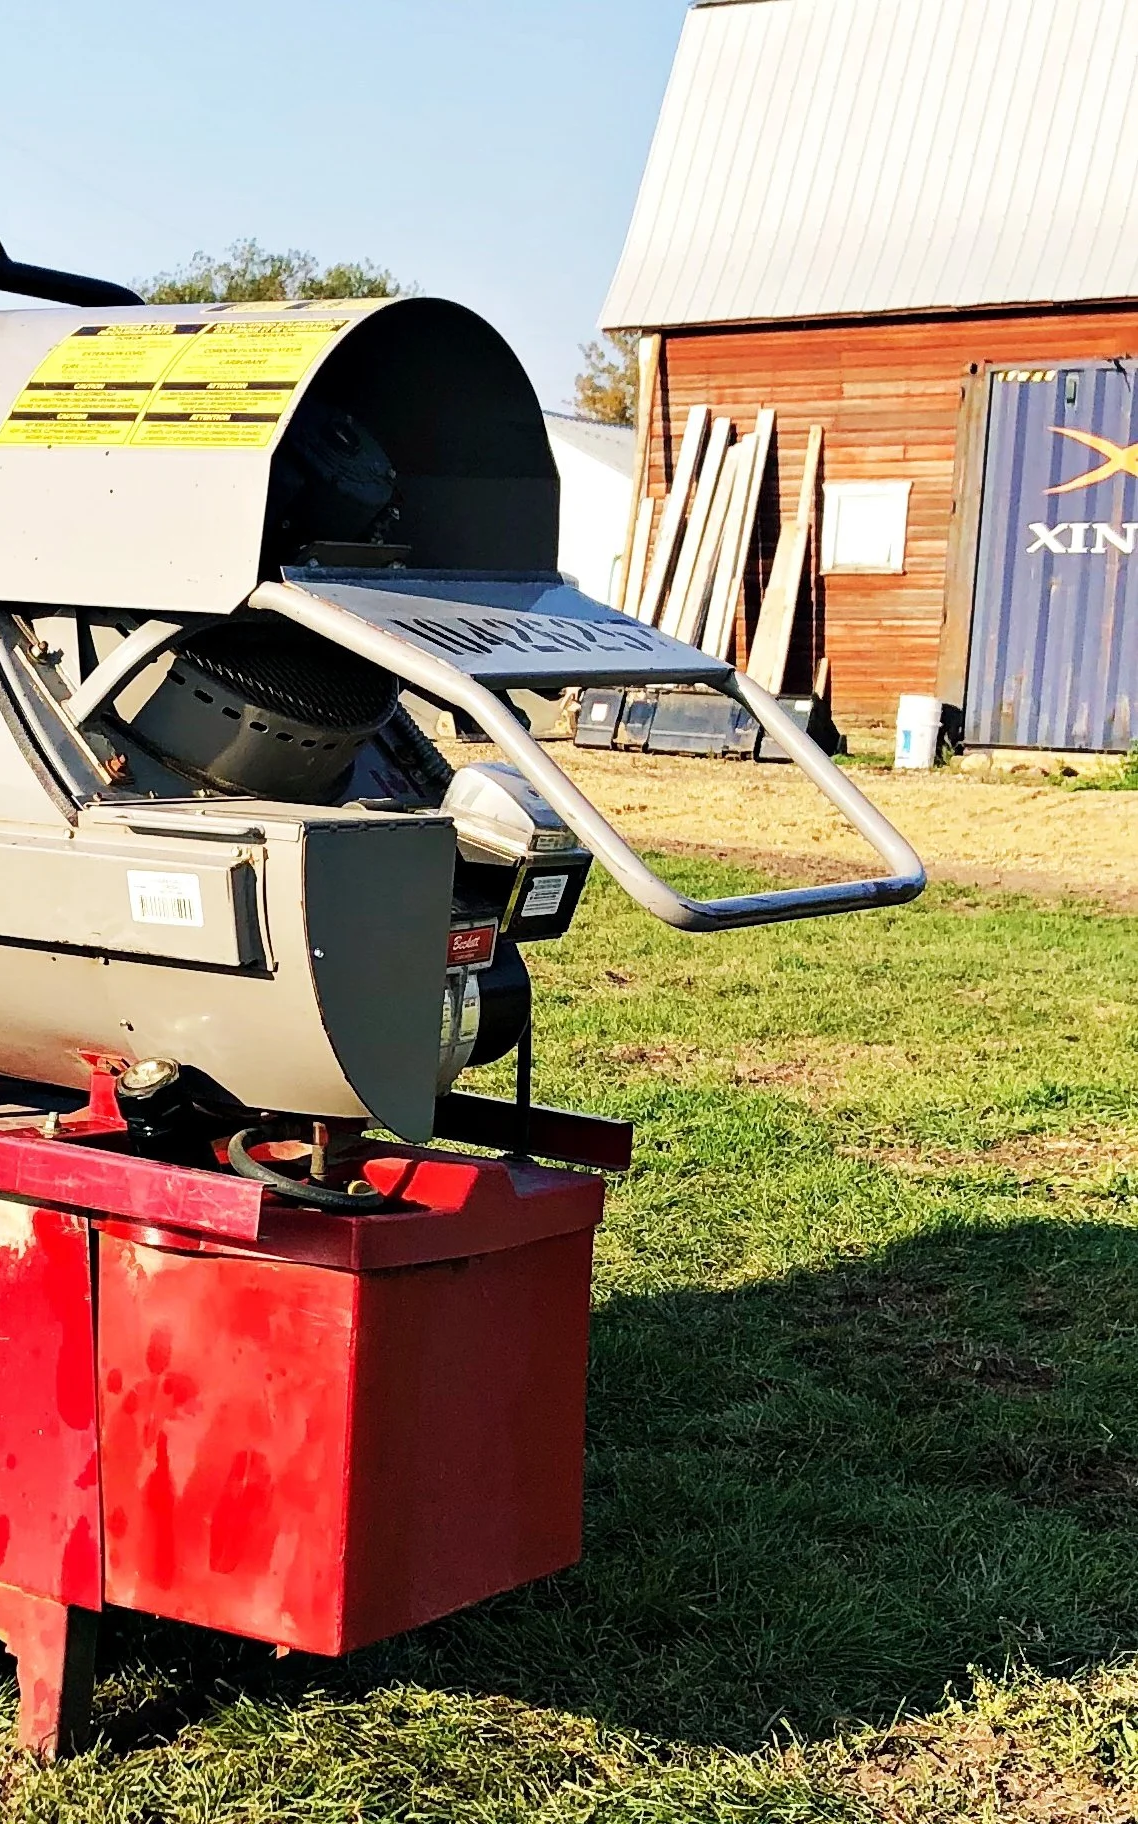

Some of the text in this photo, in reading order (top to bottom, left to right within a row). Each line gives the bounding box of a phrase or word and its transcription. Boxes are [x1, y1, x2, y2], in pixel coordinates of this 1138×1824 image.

[73, 382, 106, 390] CAUTION
[205, 382, 249, 390] ATTENTION
[56, 412, 88, 420] CAUTION
[189, 413, 232, 421] ATTENTION
[1026, 522, 1138, 554] XIN
